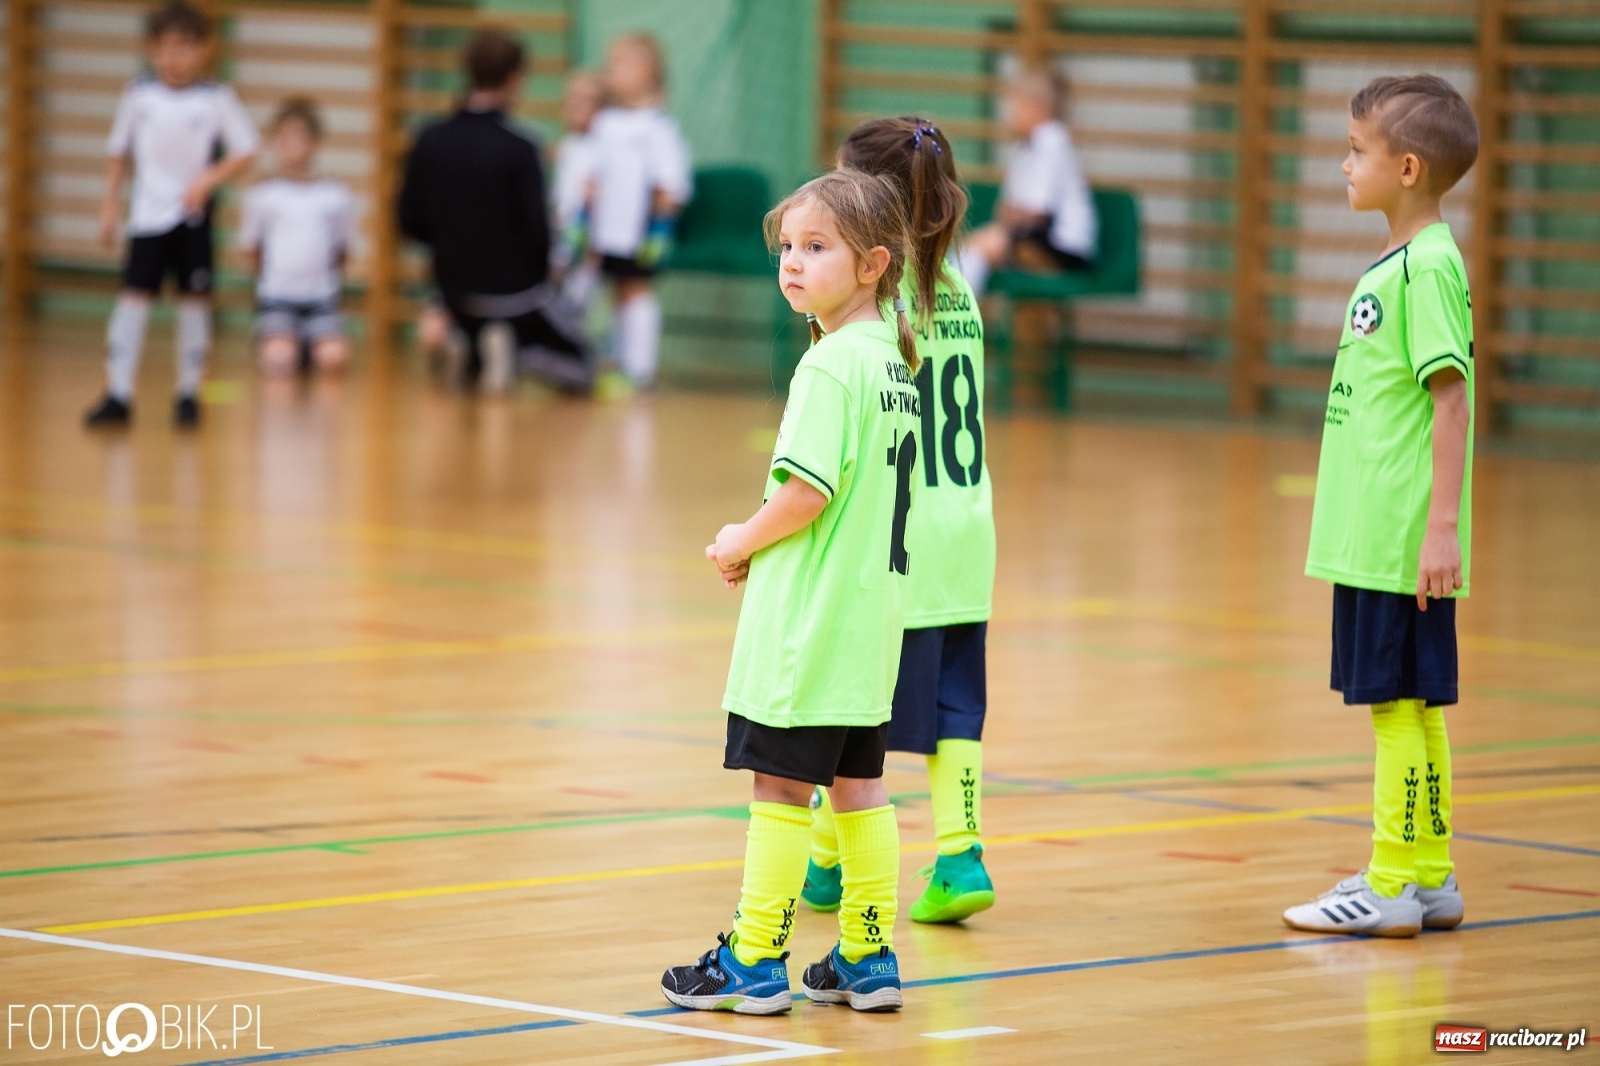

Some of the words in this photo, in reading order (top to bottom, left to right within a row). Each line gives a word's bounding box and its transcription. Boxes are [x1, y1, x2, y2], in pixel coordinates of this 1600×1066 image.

[917, 354, 984, 488] 18
[706, 965, 726, 982] FILA
[771, 966, 788, 980] FIL
[870, 962, 897, 975] FILA
